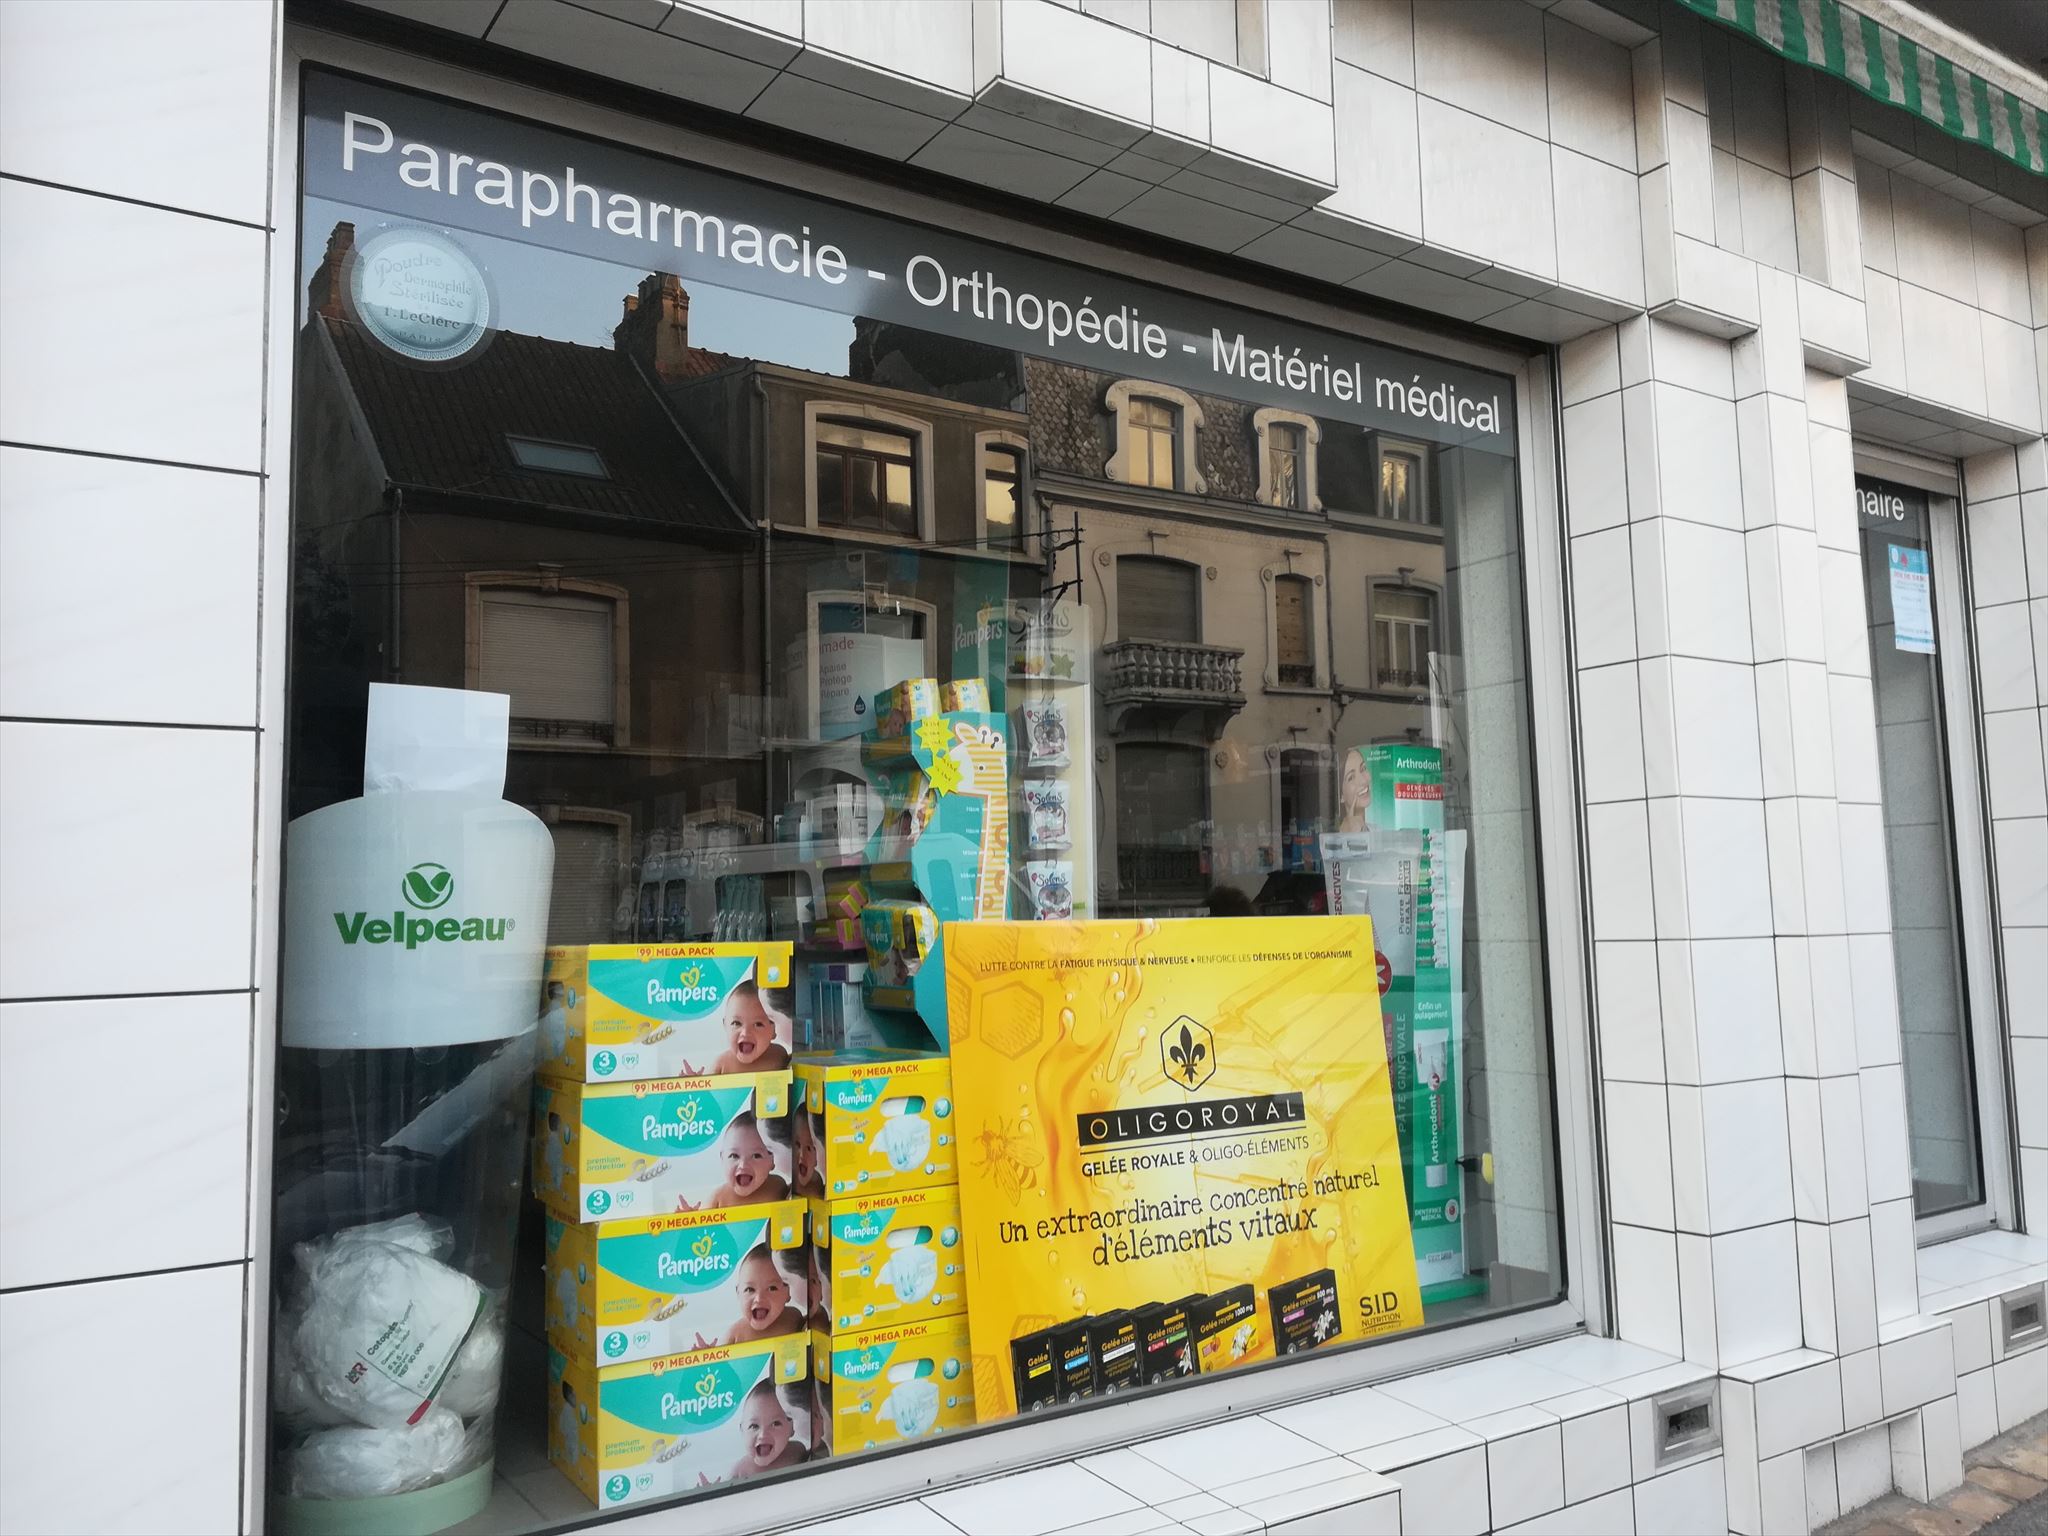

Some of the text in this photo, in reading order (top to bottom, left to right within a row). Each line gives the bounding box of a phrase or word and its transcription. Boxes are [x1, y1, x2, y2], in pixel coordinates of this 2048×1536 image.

[343, 111, 848, 285] Parapharmacie
[905, 255, 1168, 359] Orthopédie
[1211, 328, 1362, 404] Matériel
[1375, 374, 1501, 435] médical
[954, 620, 1003, 652] Pampers
[1397, 757, 1441, 770] Arthrodont
[639, 947, 715, 957] 99 MEGA PACK
[980, 962, 1007, 972] LUTTE
[1009, 961, 1045, 971] CONTRE
[1048, 960, 1058, 970] LA
[1060, 959, 1095, 969] FATIGUE
[1097, 957, 1137, 967] PHYSIQUE
[1148, 956, 1188, 965] NERVEUSE
[1197, 955, 1235, 964] RENFORCE
[1238, 954, 1250, 963] LES
[1252, 951, 1291, 962] DÉFENSES
[1293, 952, 1303, 960] DE
[1304, 950, 1353, 960] L'ORGANISME
[647, 979, 718, 1006] Pampers
[599, 1052, 610, 1067] 3
[852, 1064, 919, 1077] 99 MEGA PACK
[634, 1079, 712, 1092] 99 MEGA PACK
[838, 1092, 873, 1106] Pampers
[642, 1114, 715, 1141] Pampers
[1089, 1098, 1296, 1141] OLIGOROYAL
[1427, 1094, 1438, 1163] Arthrodont
[1081, 1135, 1309, 1178] GELÉE ROYALE & OLIGO-ÉLÉMENTS
[593, 1190, 605, 1206] 3
[857, 1193, 926, 1210] 99 MEGA PACK
[1000, 1165, 1380, 1244] Un extraordinaire concentré naturel
[649, 1213, 727, 1230] 99 MEGA PACK
[843, 1225, 880, 1239] Pampers
[1092, 1206, 1319, 1267] d'éléments vitaux
[658, 1252, 731, 1279] Pampers
[1282, 1300, 1300, 1314] Gelée
[1200, 1319, 1218, 1335] Gelée
[1218, 1311, 1235, 1326] royale
[1361, 1312, 1401, 1328] NUTRITION
[858, 1325, 928, 1346] 99 MEGA PACK
[1147, 1321, 1185, 1342] Gelée royale
[609, 1333, 621, 1349] 3
[1101, 1337, 1121, 1352] Gelée
[652, 1349, 730, 1371] 99 MEGA PACK
[1027, 1353, 1049, 1367] Gelée
[1064, 1345, 1084, 1360] Gelée
[844, 1360, 880, 1376] Pampers
[661, 1391, 734, 1420] Pampers
[612, 1476, 624, 1493] 3
